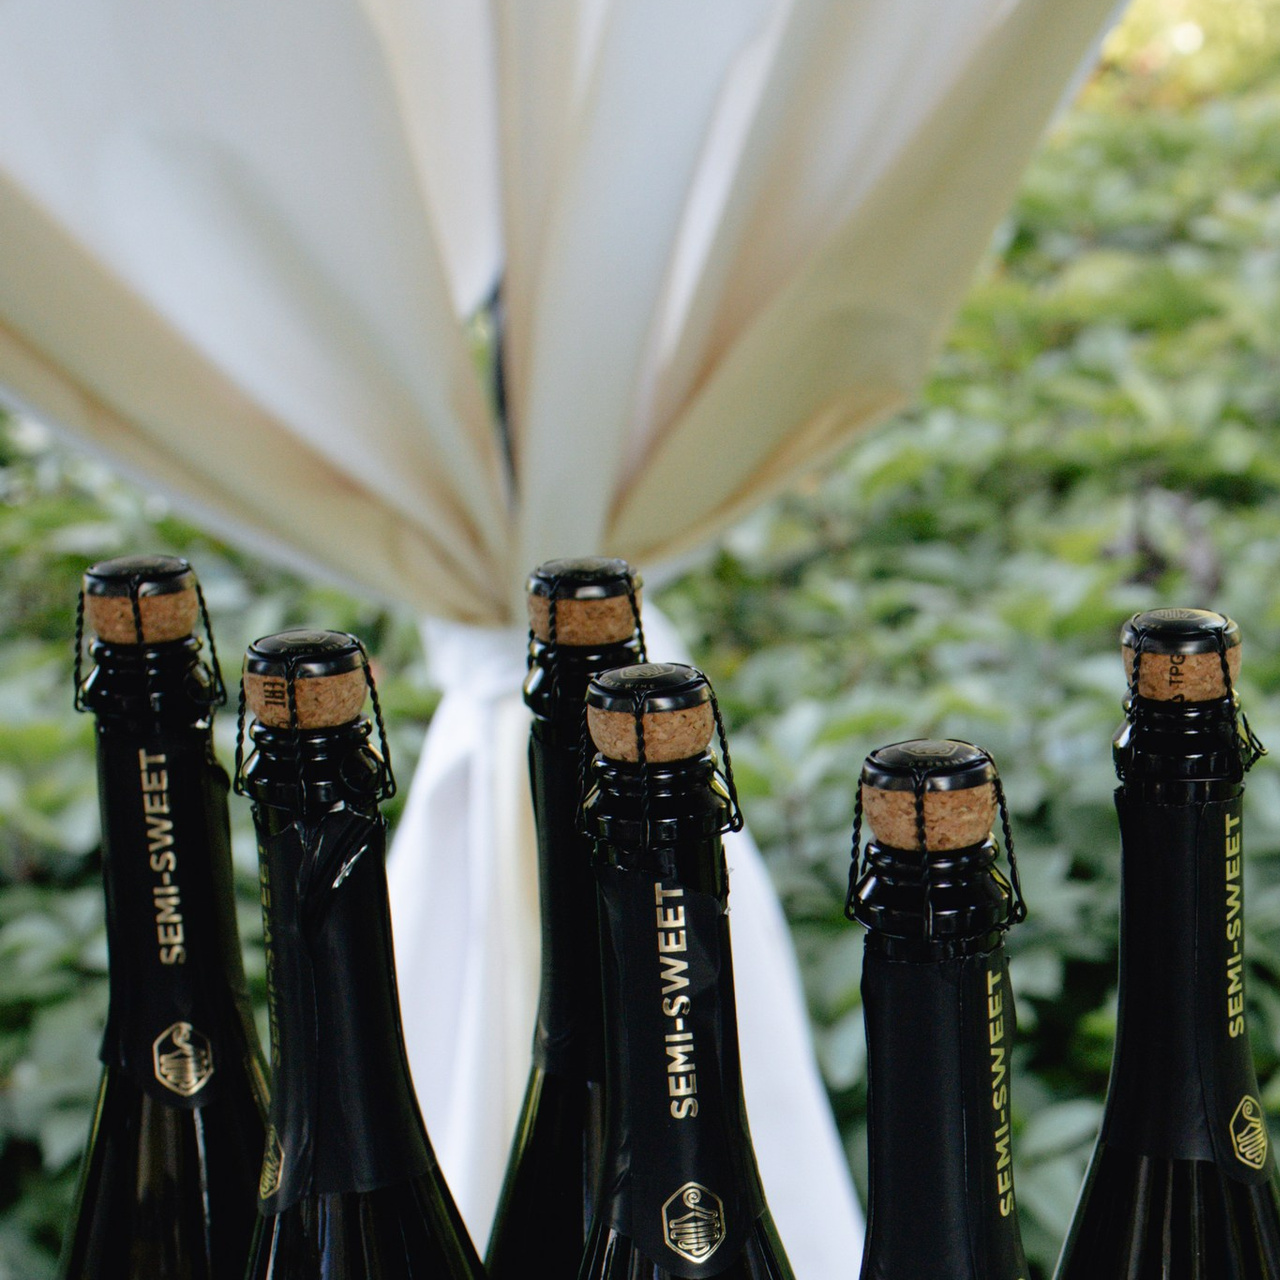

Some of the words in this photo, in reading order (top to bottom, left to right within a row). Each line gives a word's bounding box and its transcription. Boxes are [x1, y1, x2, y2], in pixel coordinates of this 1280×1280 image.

[138, 748, 187, 965] SEMI-SWEET
[1225, 813, 1245, 1038] SEMI-SWEET
[654, 882, 698, 1120] SEMI-SWEET
[987, 969, 1014, 1217] SEMI-SWEET
